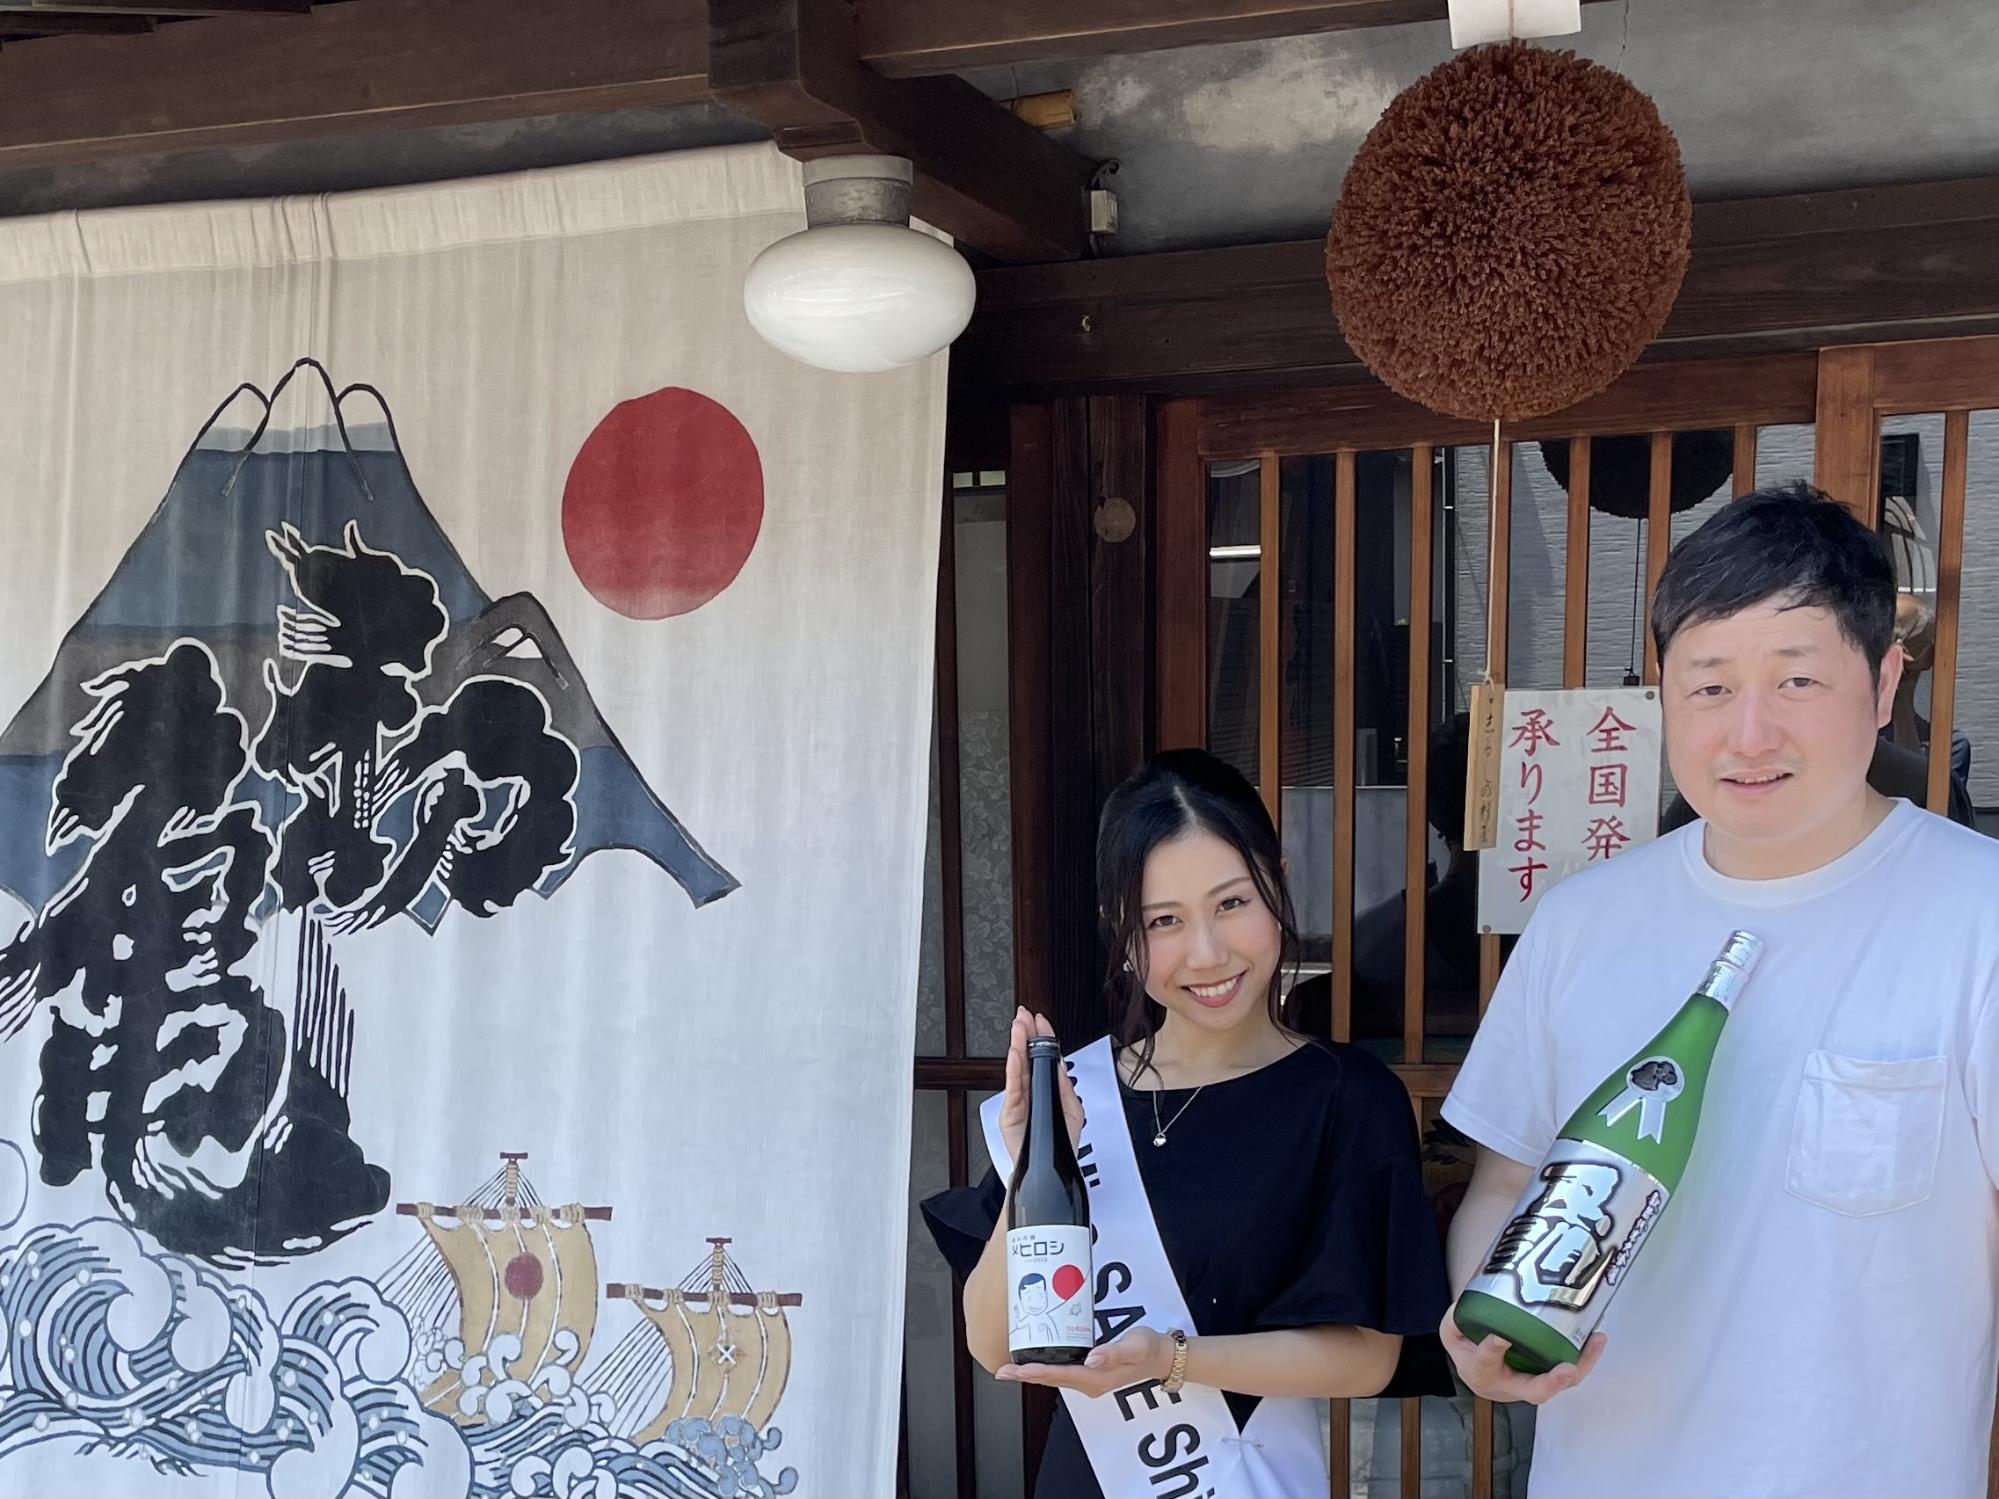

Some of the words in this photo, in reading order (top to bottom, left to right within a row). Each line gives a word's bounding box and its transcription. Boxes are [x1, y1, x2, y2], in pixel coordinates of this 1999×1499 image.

[1508, 708, 1561, 903] 承ります
[1012, 1241, 1065, 1257] 父ヒロシ
[1094, 1261, 1182, 1421] SAE
